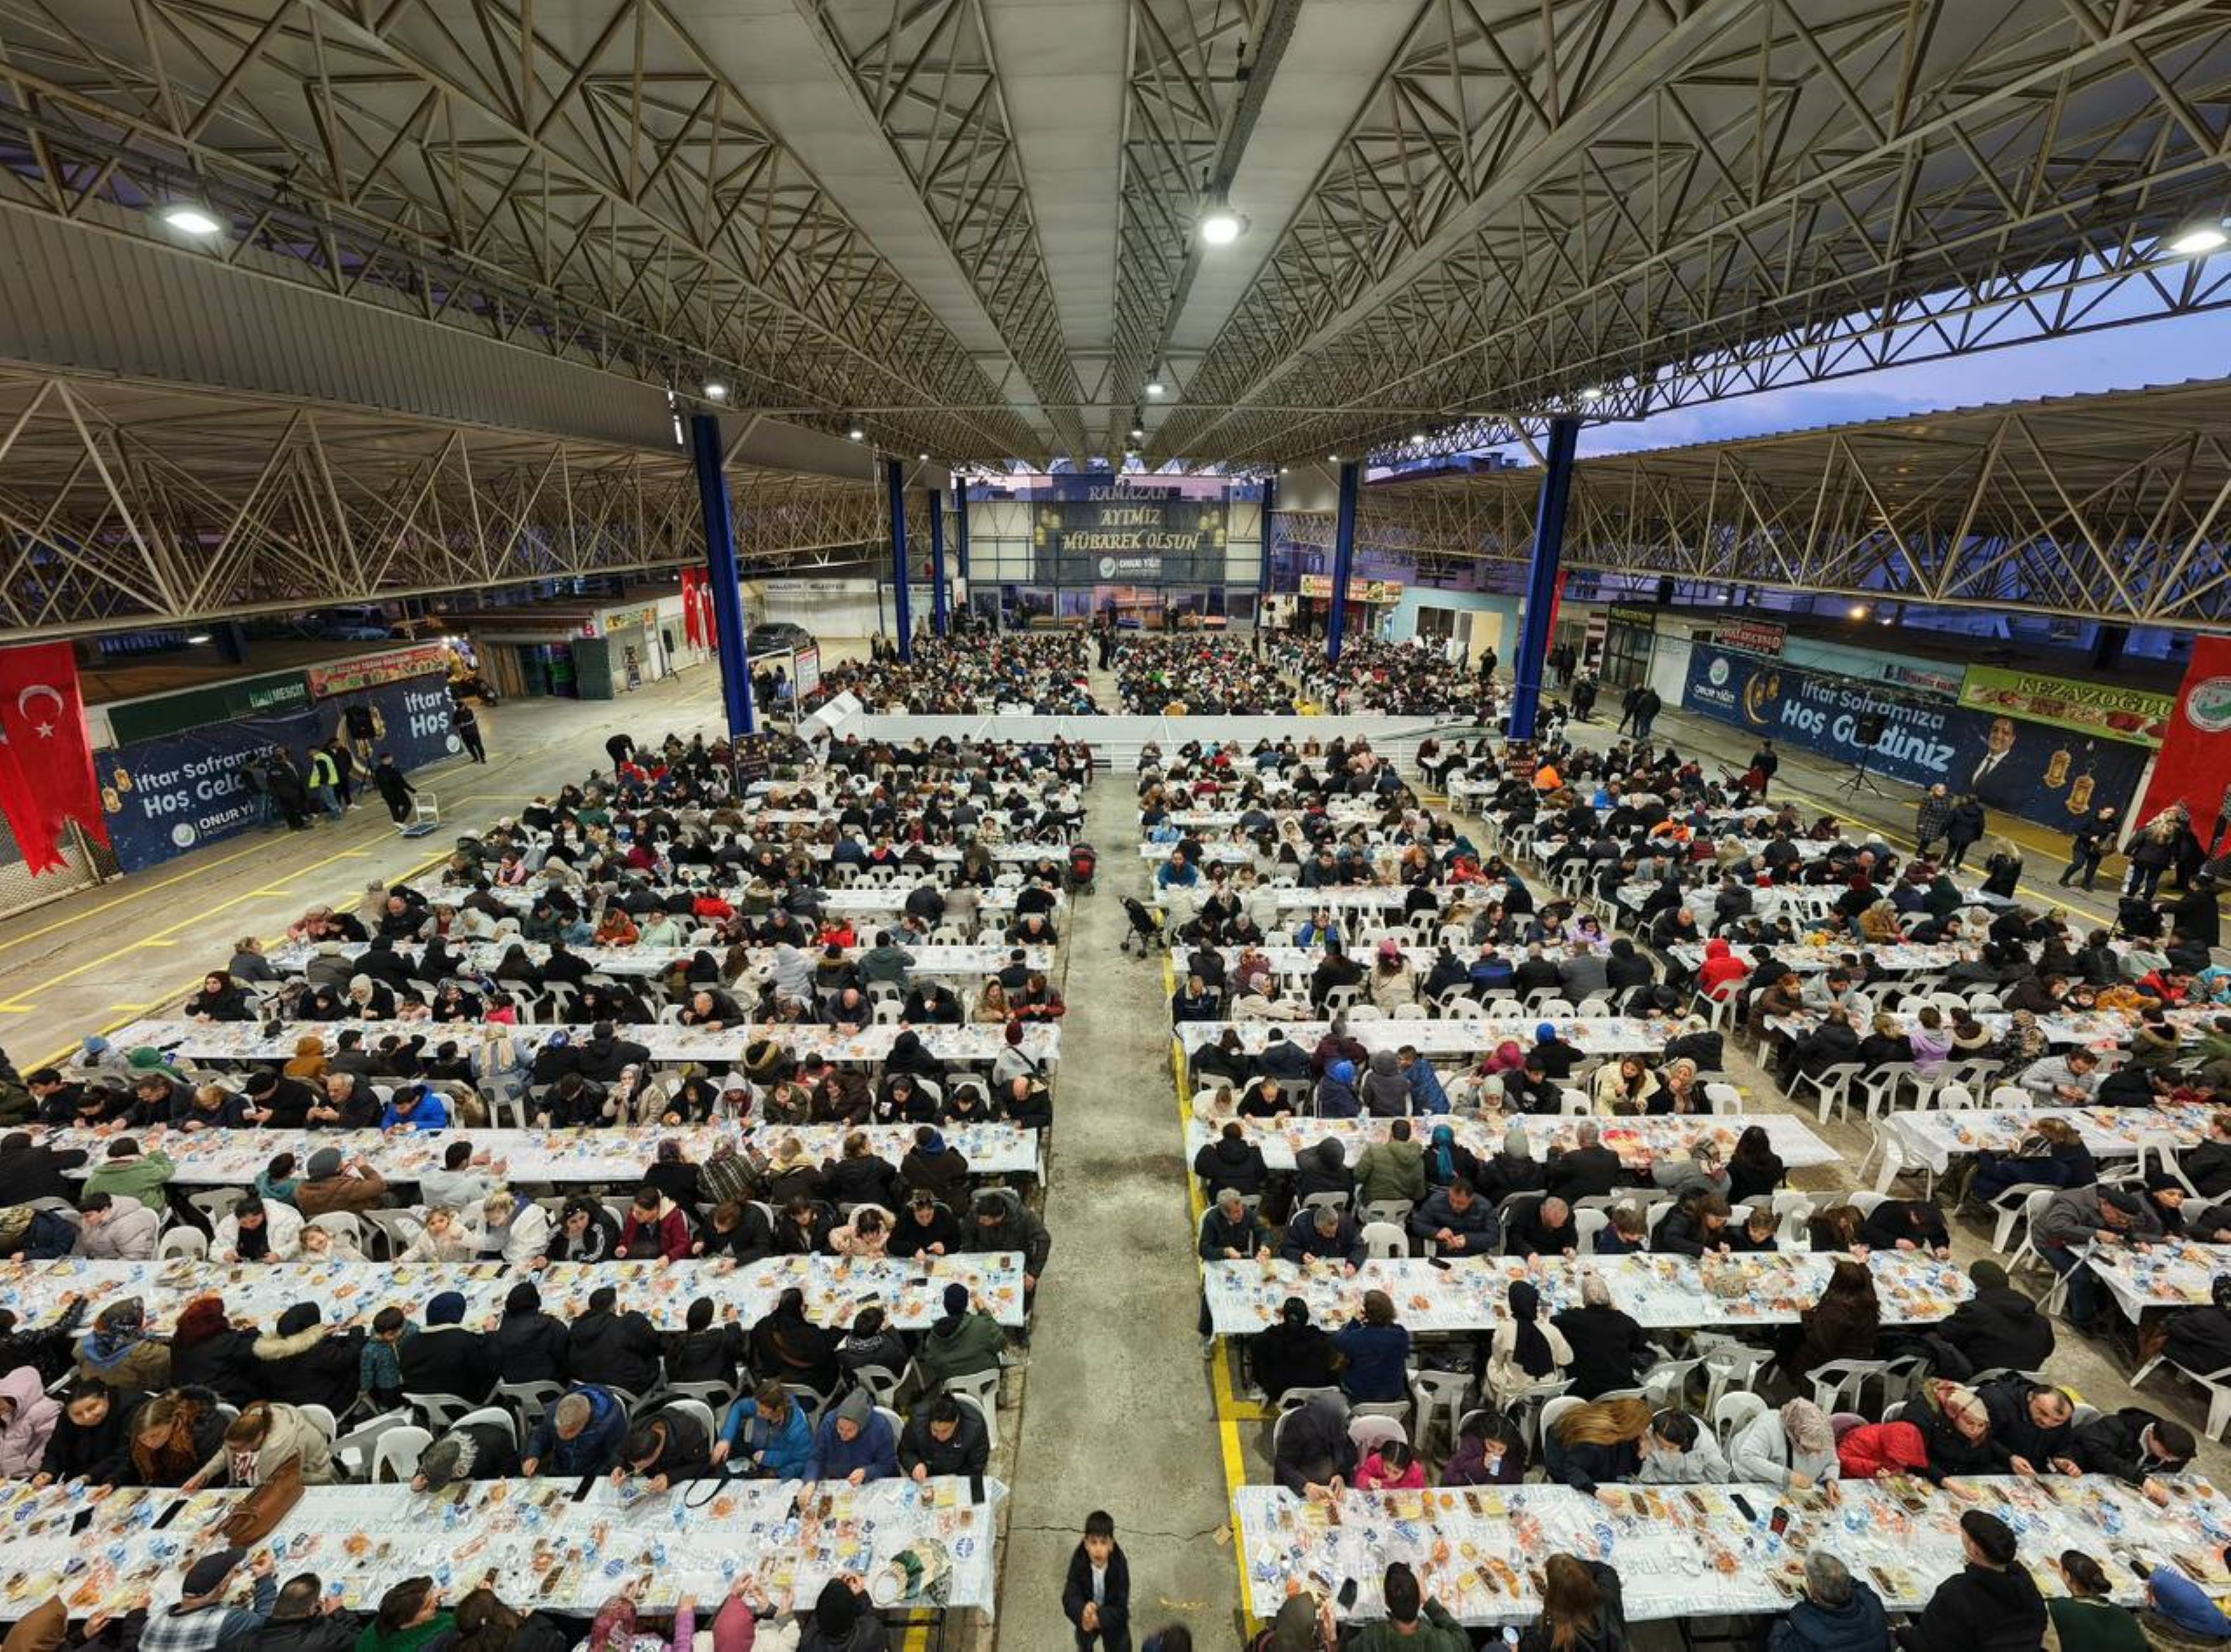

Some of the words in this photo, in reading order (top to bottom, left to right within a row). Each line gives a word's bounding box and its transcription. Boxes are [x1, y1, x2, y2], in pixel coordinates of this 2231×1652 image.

[1088, 486, 1169, 501] RAMAZAN
[1063, 530, 1147, 550] MÜBAREK
[1147, 532, 1204, 550] OLSUN
[1840, 691, 1945, 730] Soframıza
[410, 711, 449, 739] Hoş
[1781, 699, 1826, 739] Hoş
[1832, 715, 1955, 772] Gdiniz
[143, 790, 190, 819] Hoş
[200, 808, 240, 829] ONUR
